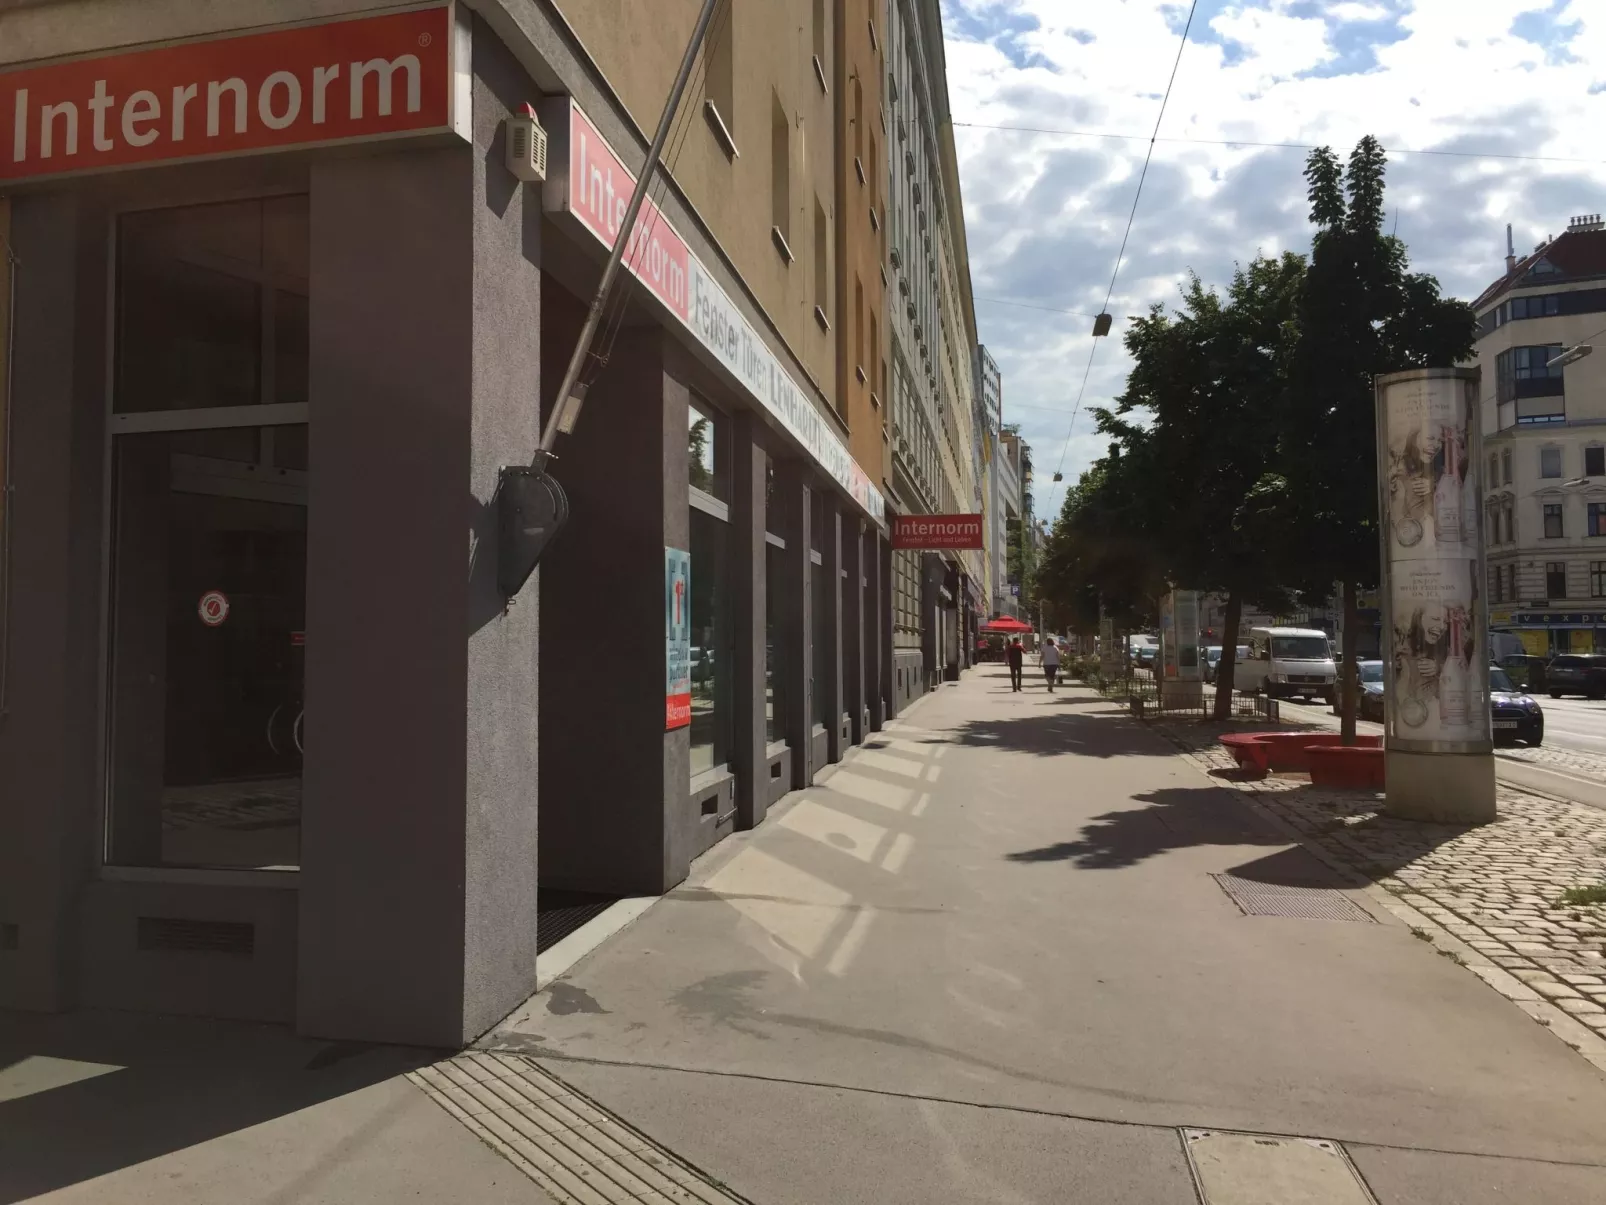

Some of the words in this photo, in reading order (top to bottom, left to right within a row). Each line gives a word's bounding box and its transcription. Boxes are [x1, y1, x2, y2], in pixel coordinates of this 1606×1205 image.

[13, 53, 422, 163] Internorm
[580, 132, 684, 309] Internorm
[695, 271, 739, 365] Fenster
[741, 326, 767, 396] Türen
[894, 520, 979, 535] Internorm
